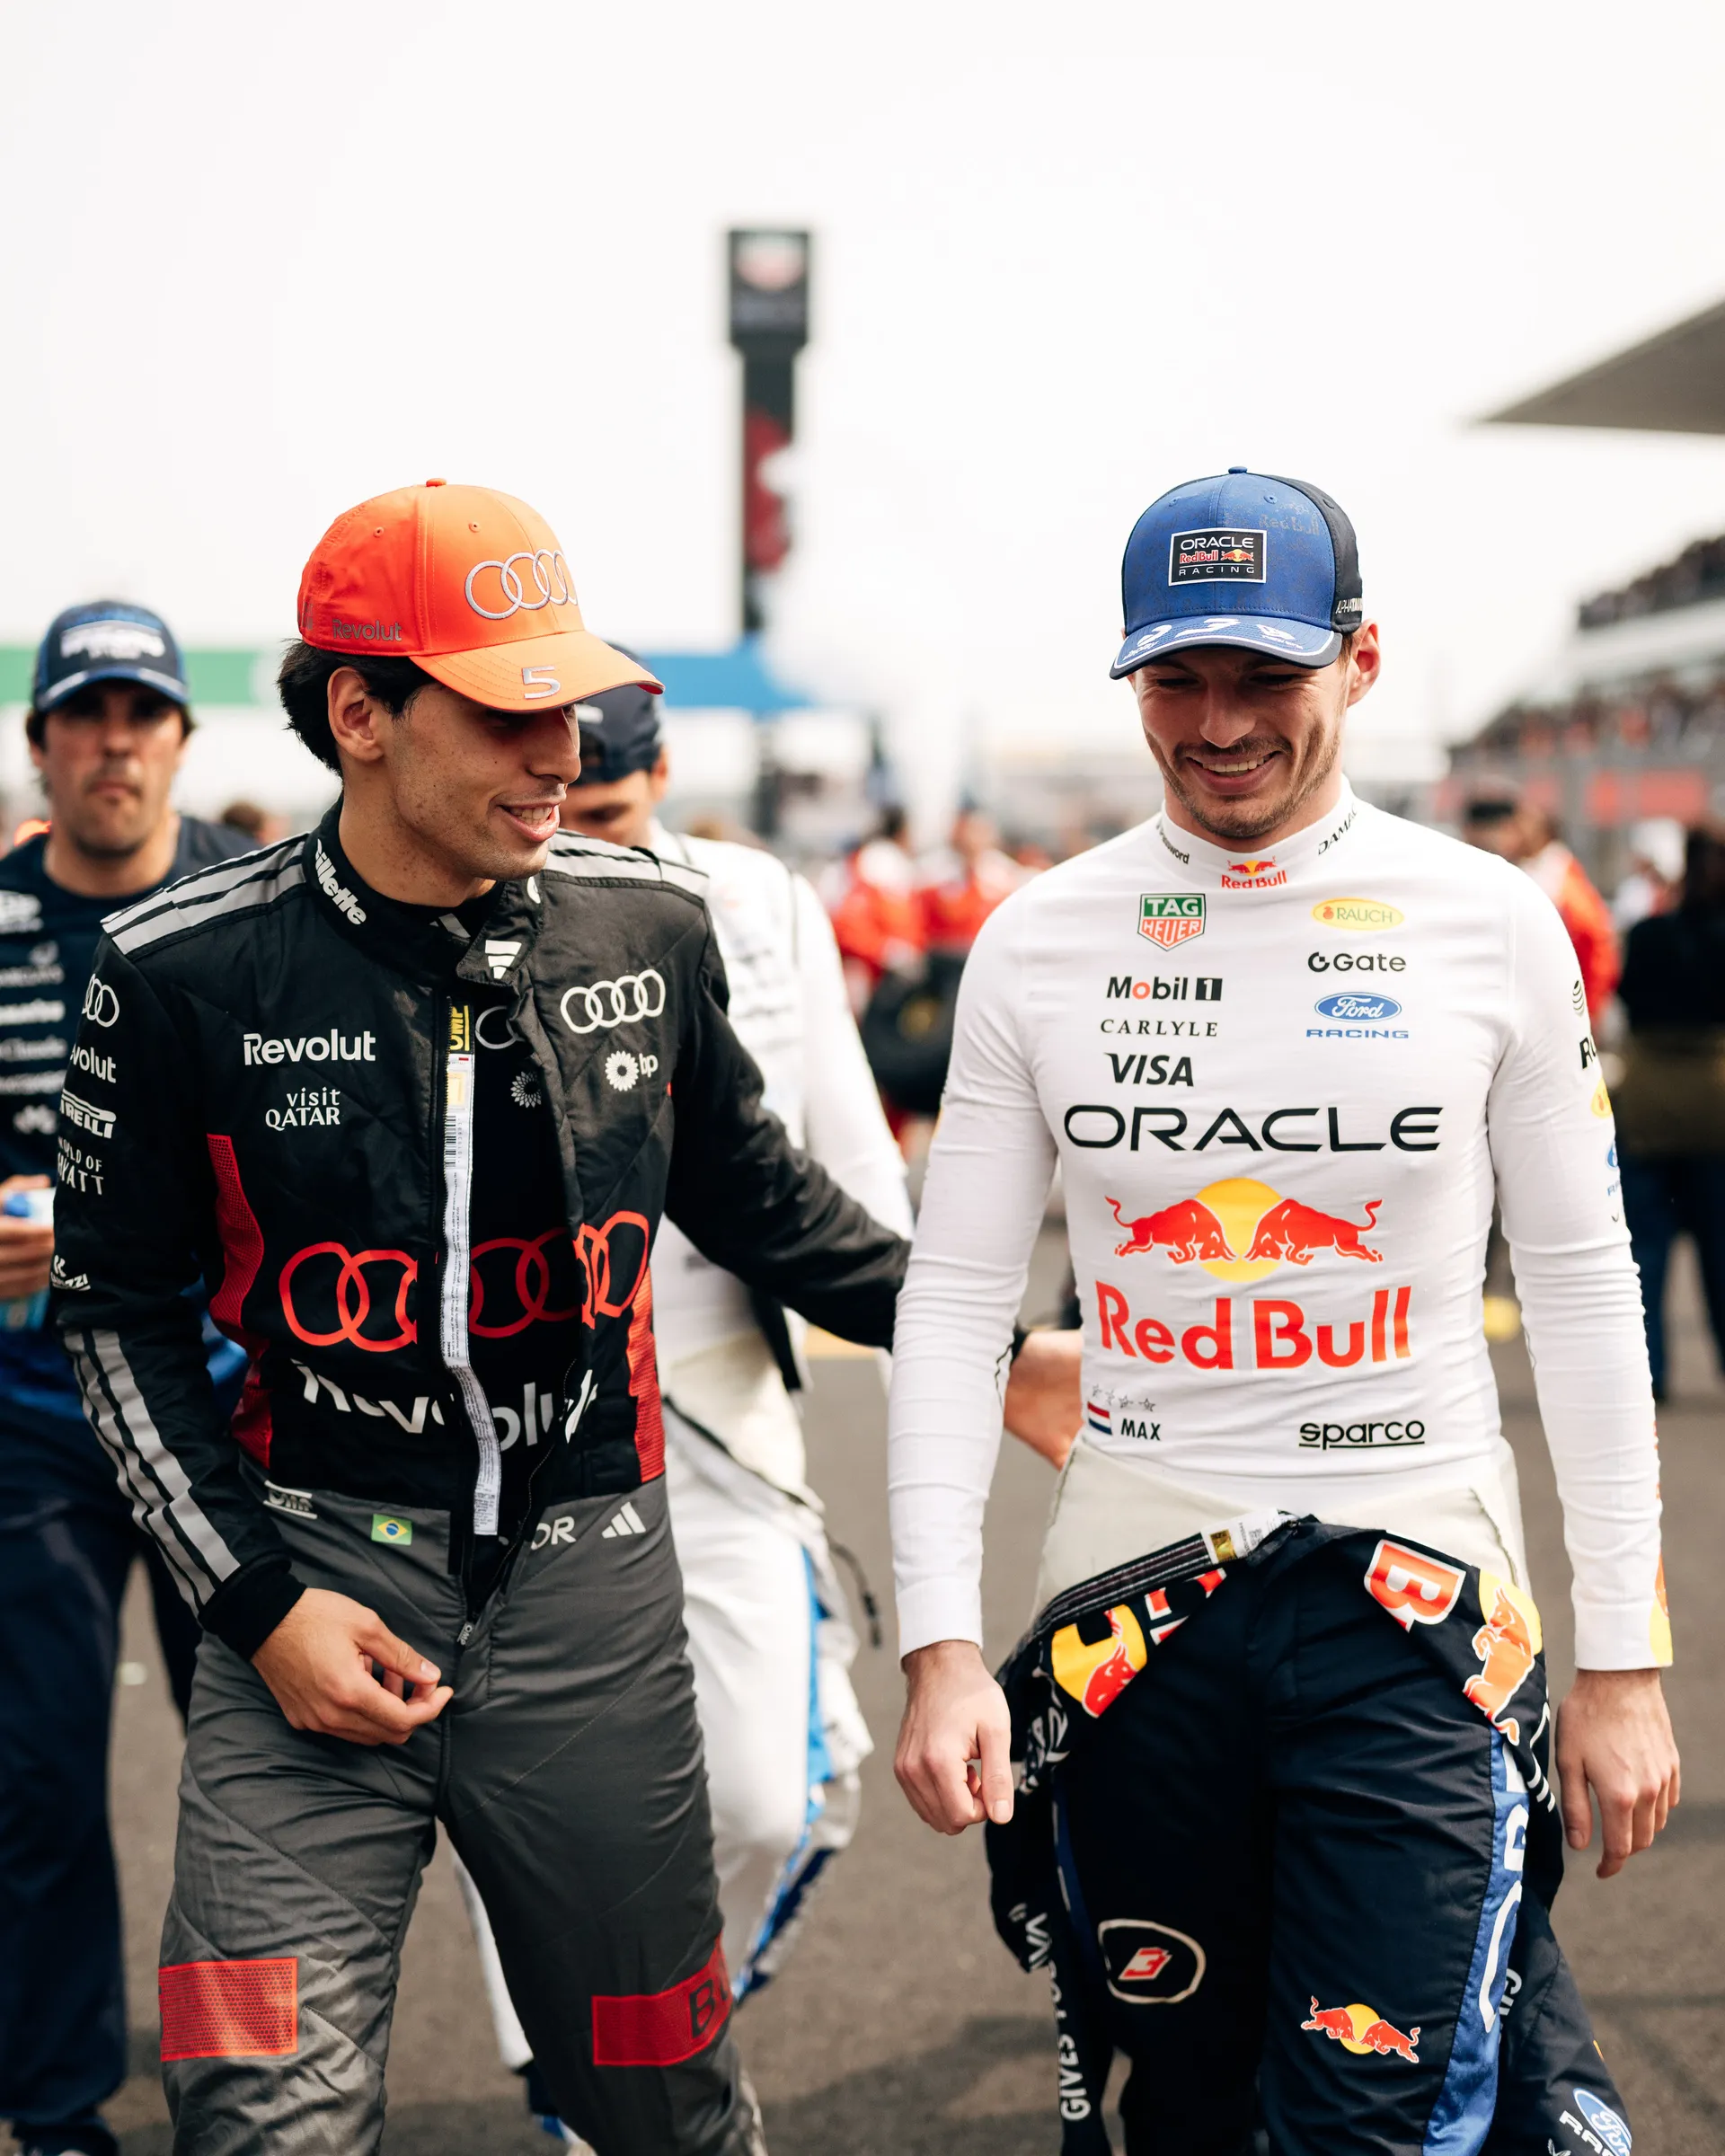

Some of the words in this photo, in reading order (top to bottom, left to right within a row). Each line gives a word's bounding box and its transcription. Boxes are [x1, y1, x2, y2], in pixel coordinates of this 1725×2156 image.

[1180, 536, 1255, 551] ORACLE
[1179, 566, 1255, 577] RACING
[332, 619, 403, 642] Revolut
[522, 665, 562, 700] 5
[1221, 874, 1253, 889] Red
[1255, 870, 1287, 888] Bull
[1146, 897, 1200, 917] TAG
[1336, 906, 1393, 924] RAUCH
[1142, 918, 1201, 948] HEUER
[1105, 976, 1189, 1002] Mobil
[1331, 994, 1384, 1019] Ford
[1100, 1018, 1218, 1038] CARLYLE
[1305, 1028, 1410, 1039] RACING
[243, 1029, 376, 1065] Revolut
[70, 1043, 117, 1084] volut
[639, 1053, 659, 1078] bp
[1103, 1052, 1195, 1087] VISA
[286, 1087, 341, 1107] visit
[265, 1108, 341, 1132] QATAR
[1063, 1104, 1445, 1153] ORACLE
[85, 1155, 102, 1172] OF
[1095, 1279, 1234, 1370] Red
[1252, 1285, 1412, 1370] Bull
[1119, 1418, 1162, 1442] MAX
[1298, 1419, 1426, 1451] sparco
[530, 1515, 577, 1551] OR
[1059, 2034, 1092, 2122] GIVES
